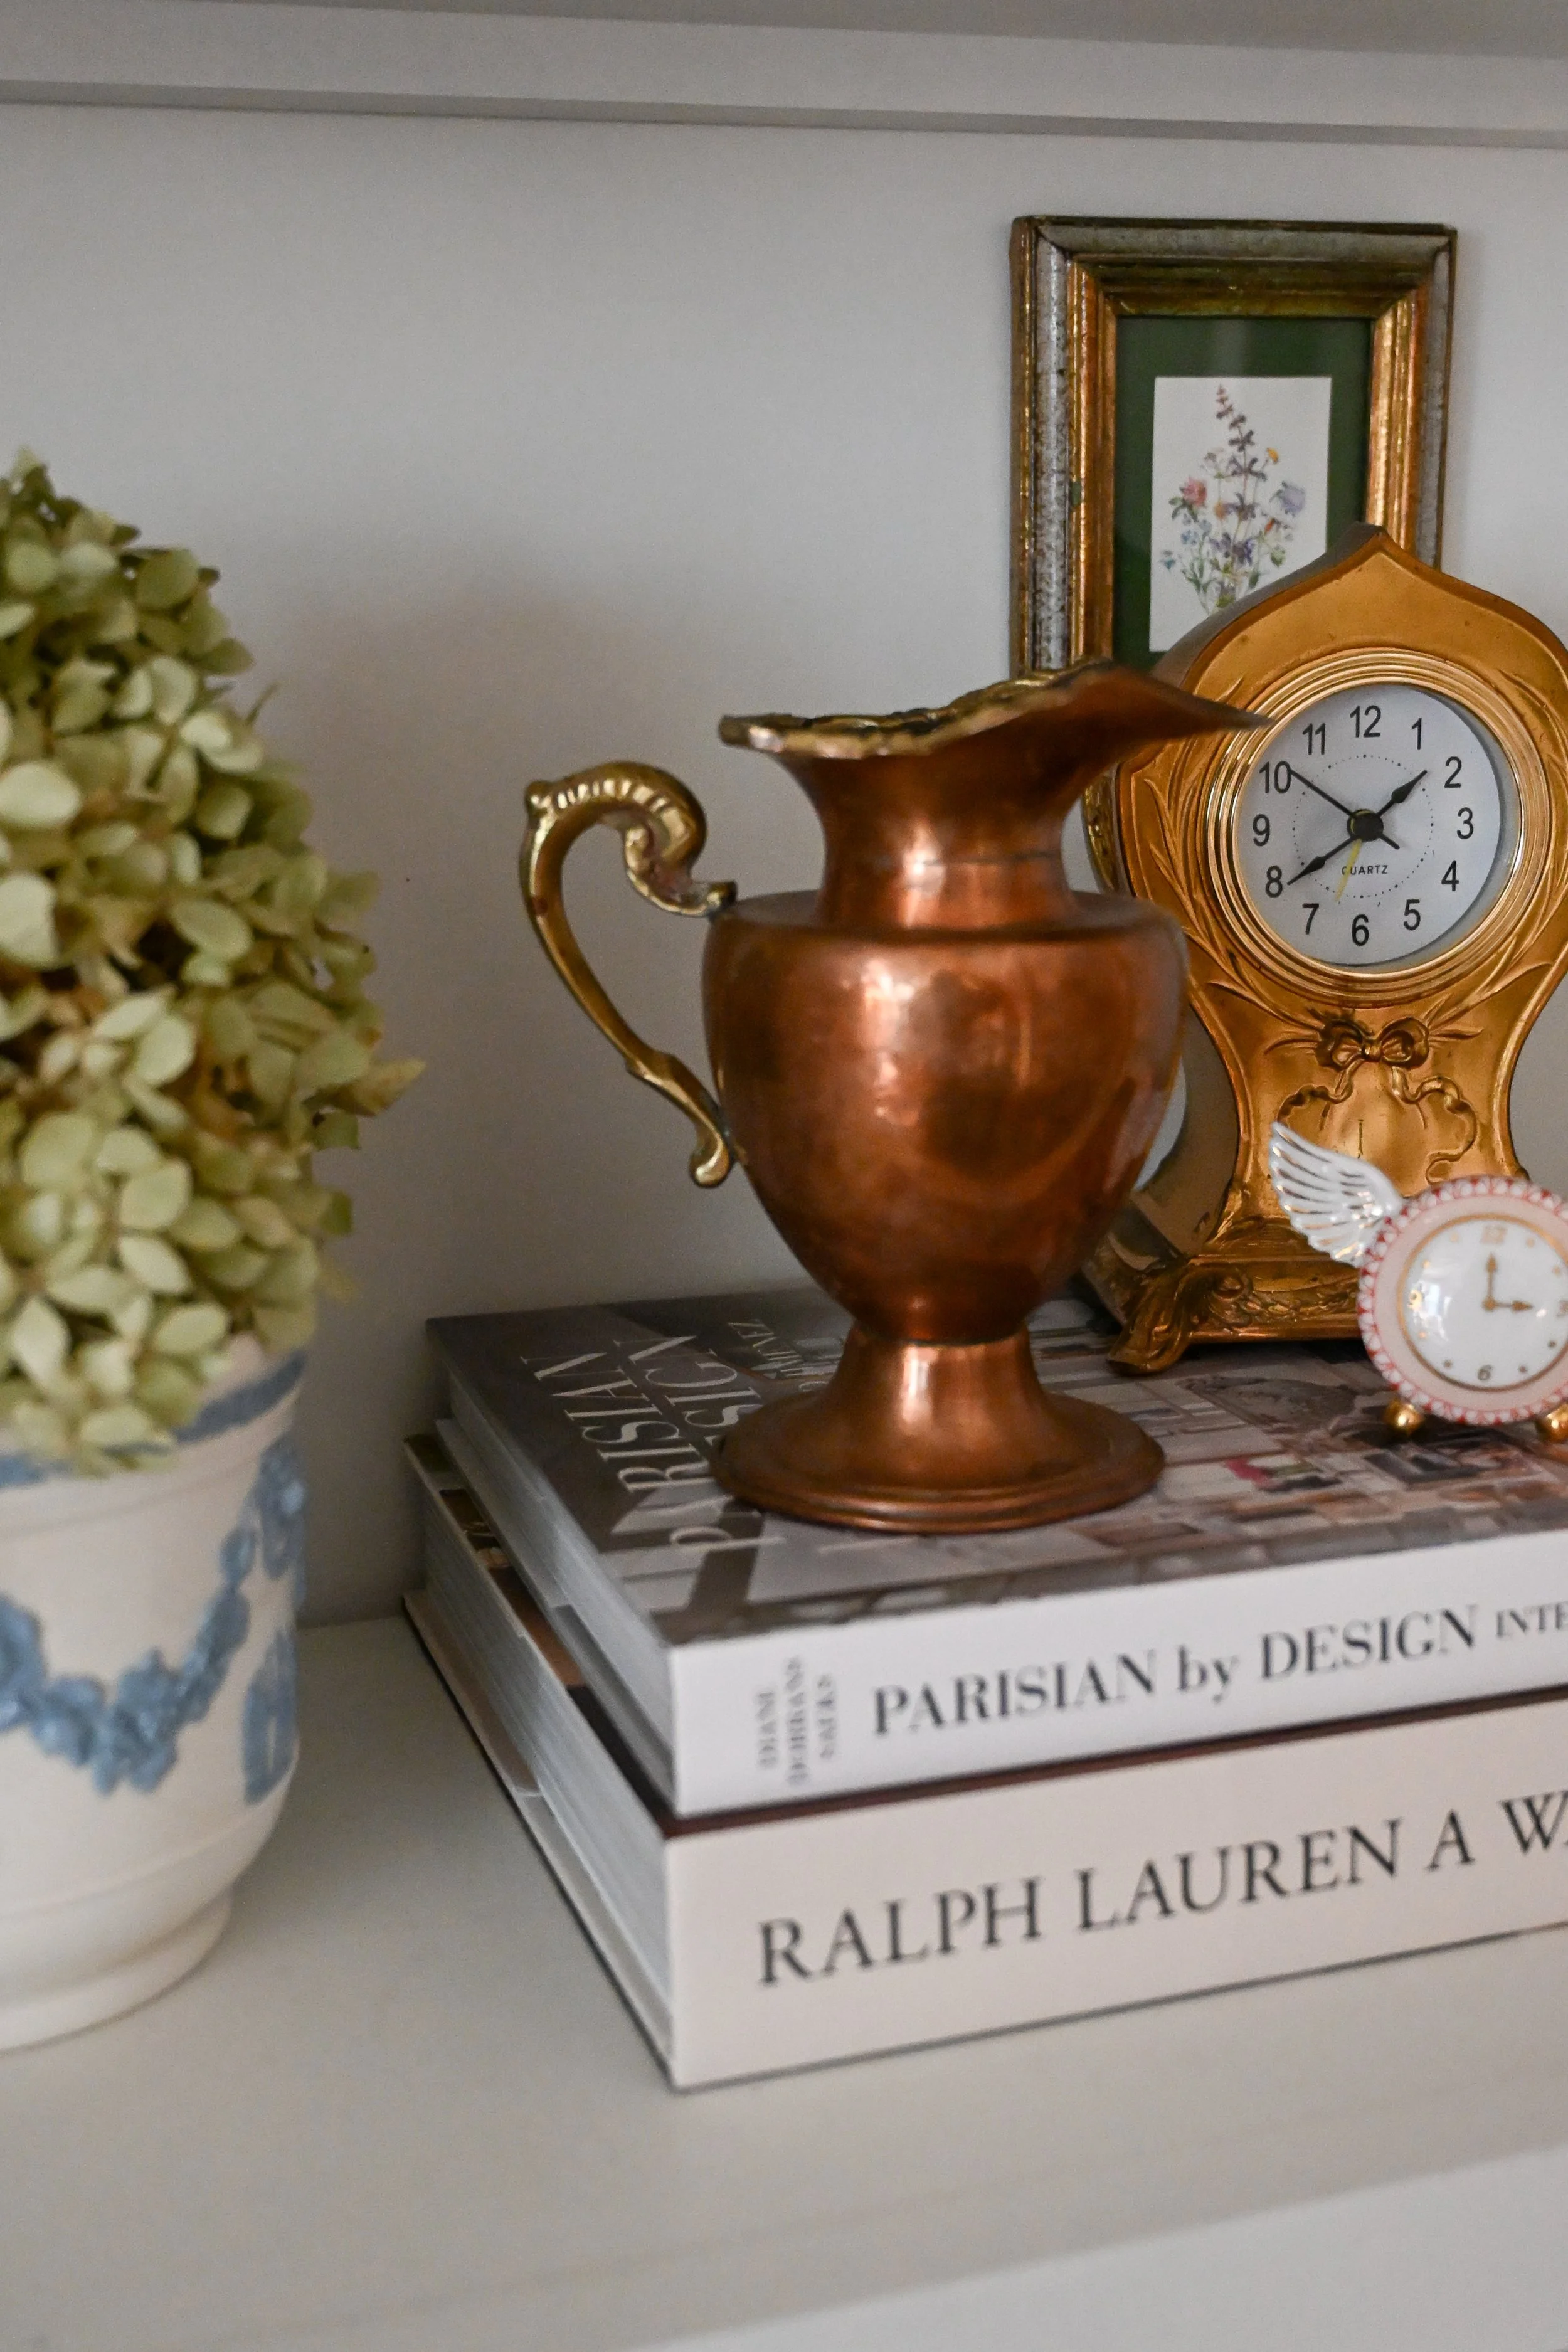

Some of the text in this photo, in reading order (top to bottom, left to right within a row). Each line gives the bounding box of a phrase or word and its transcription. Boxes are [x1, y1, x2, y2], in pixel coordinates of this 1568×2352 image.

[1350, 704, 1381, 738] 12
[1411, 718, 1422, 750] 1
[1302, 723, 1327, 755] 11
[1259, 760, 1292, 794] 10
[1444, 756, 1462, 788] 2
[1253, 814, 1271, 847] 9
[1456, 807, 1474, 840] 3
[1264, 866, 1283, 898] 8
[1441, 859, 1459, 892] 4
[1302, 903, 1320, 935] 7
[1351, 914, 1370, 947] 6
[1403, 898, 1421, 931] 5
[1477, 1364, 1493, 1382] 6
[613, 1335, 764, 1445] SIGN
[873, 1649, 1156, 1737] PARISIAN
[1177, 1644, 1239, 1705] by
[1260, 1604, 1478, 1681] DESIGN
[757, 1789, 1568, 1988] RALPH LAUREN A W
